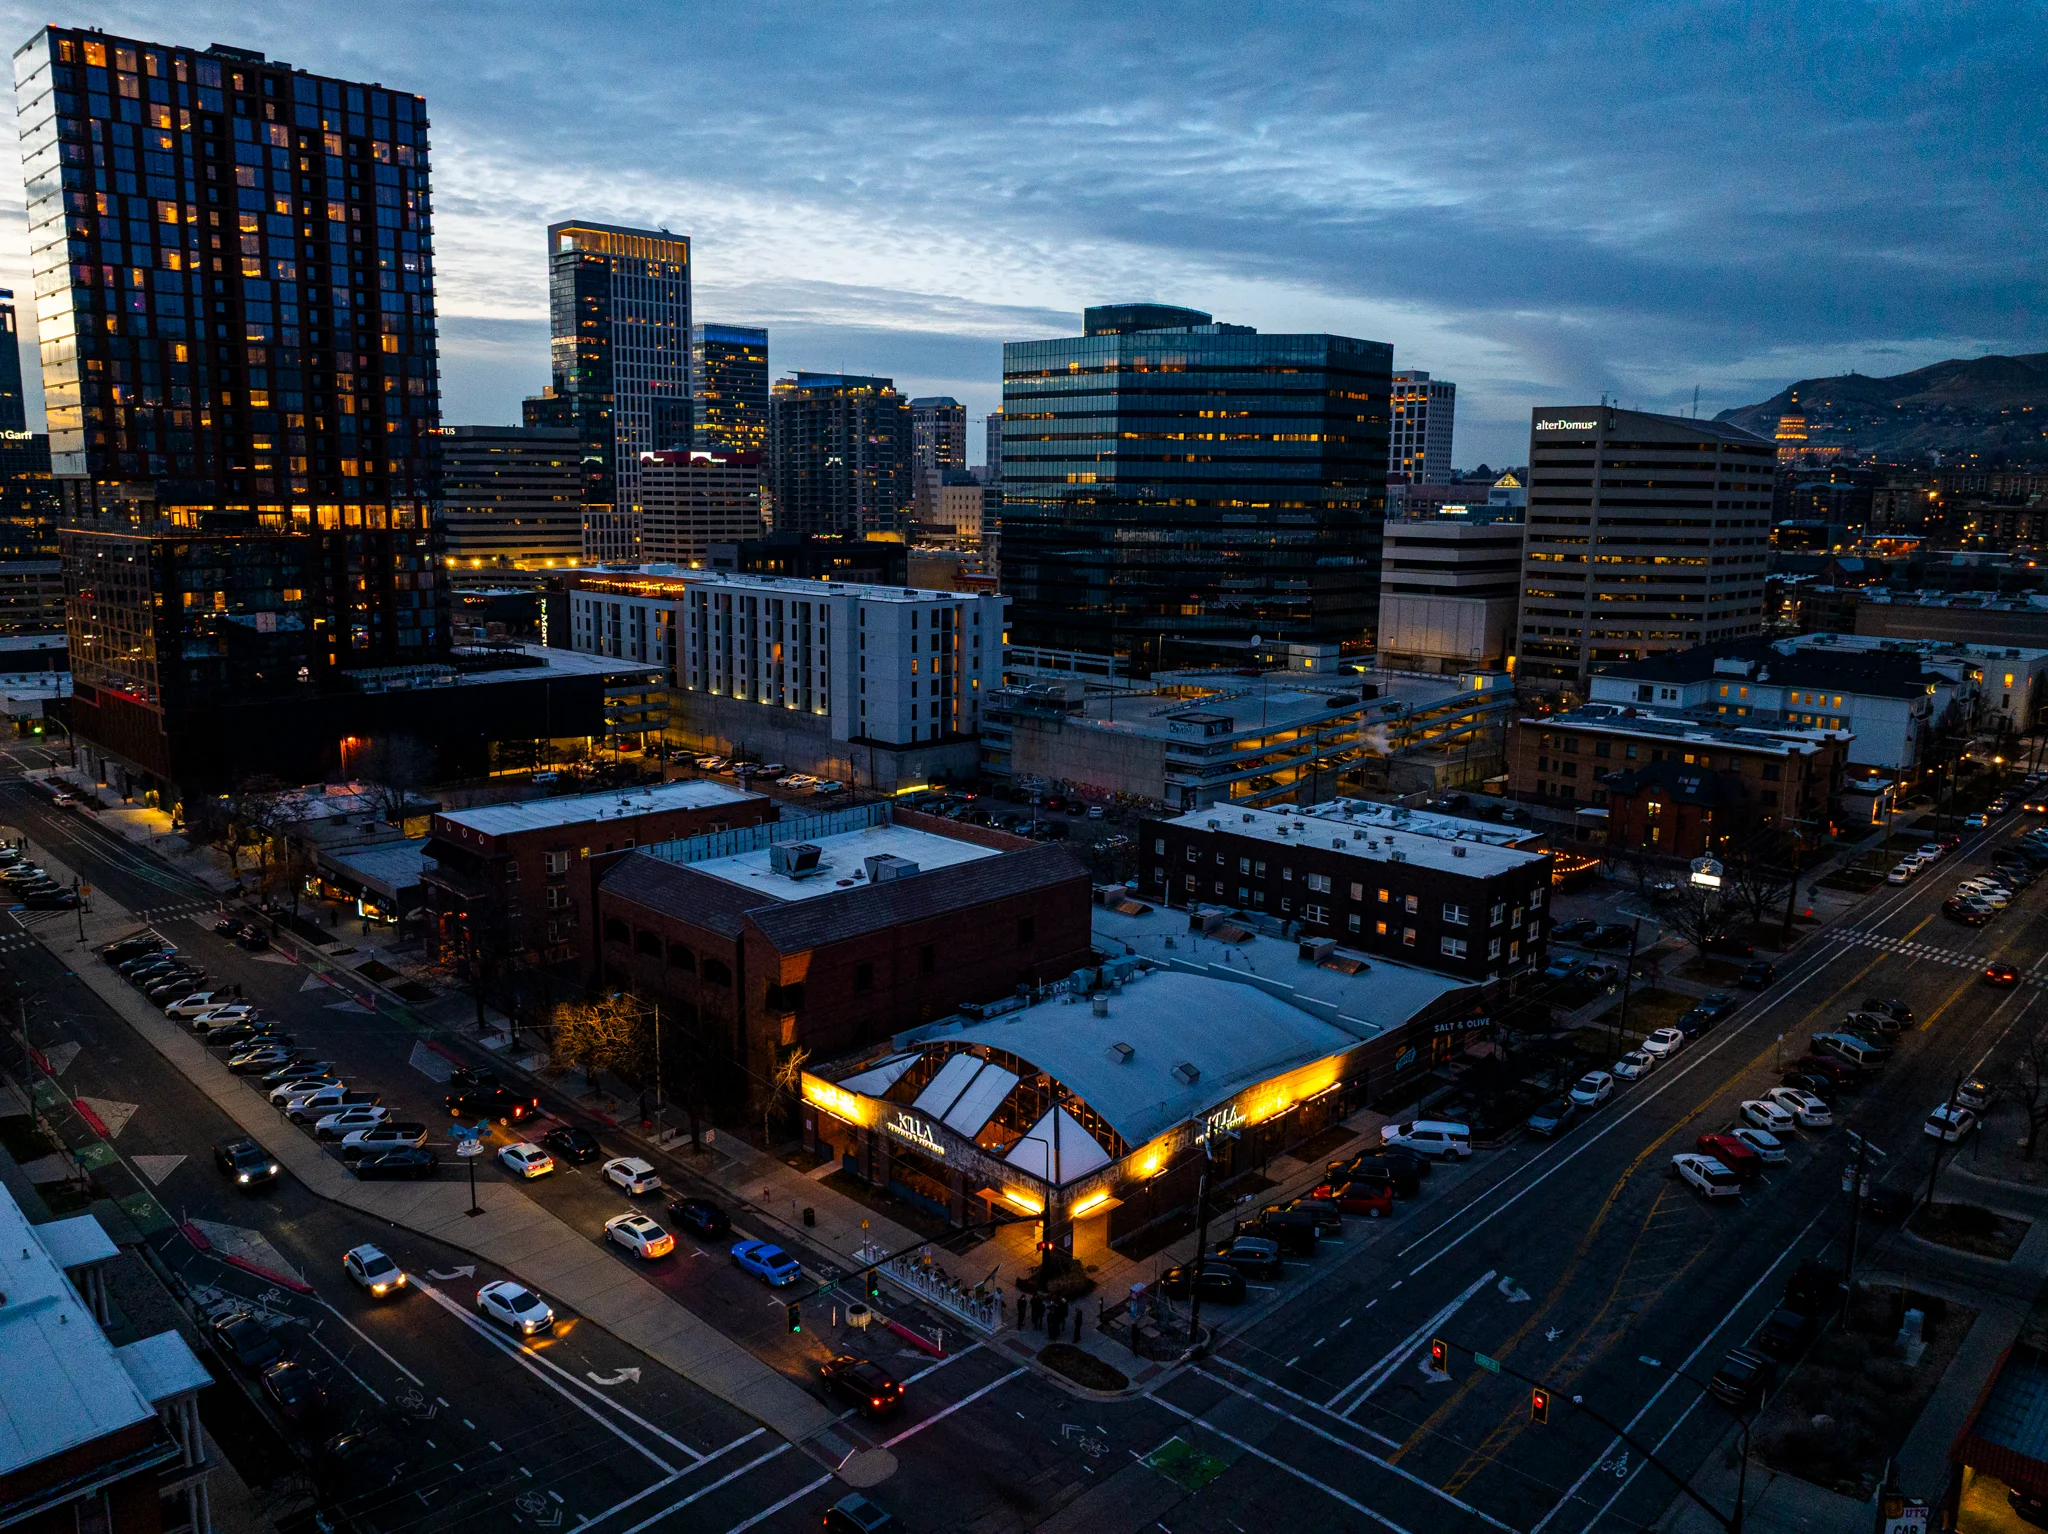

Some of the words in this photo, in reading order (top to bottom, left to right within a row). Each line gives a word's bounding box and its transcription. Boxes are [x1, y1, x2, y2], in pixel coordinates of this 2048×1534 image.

[1536, 420, 1594, 431] alterDomus
[5, 430, 33, 440] Garff
[1434, 1022, 1455, 1033] SALT
[1457, 1020, 1464, 1030] &
[1466, 1017, 1491, 1028] OLIVE
